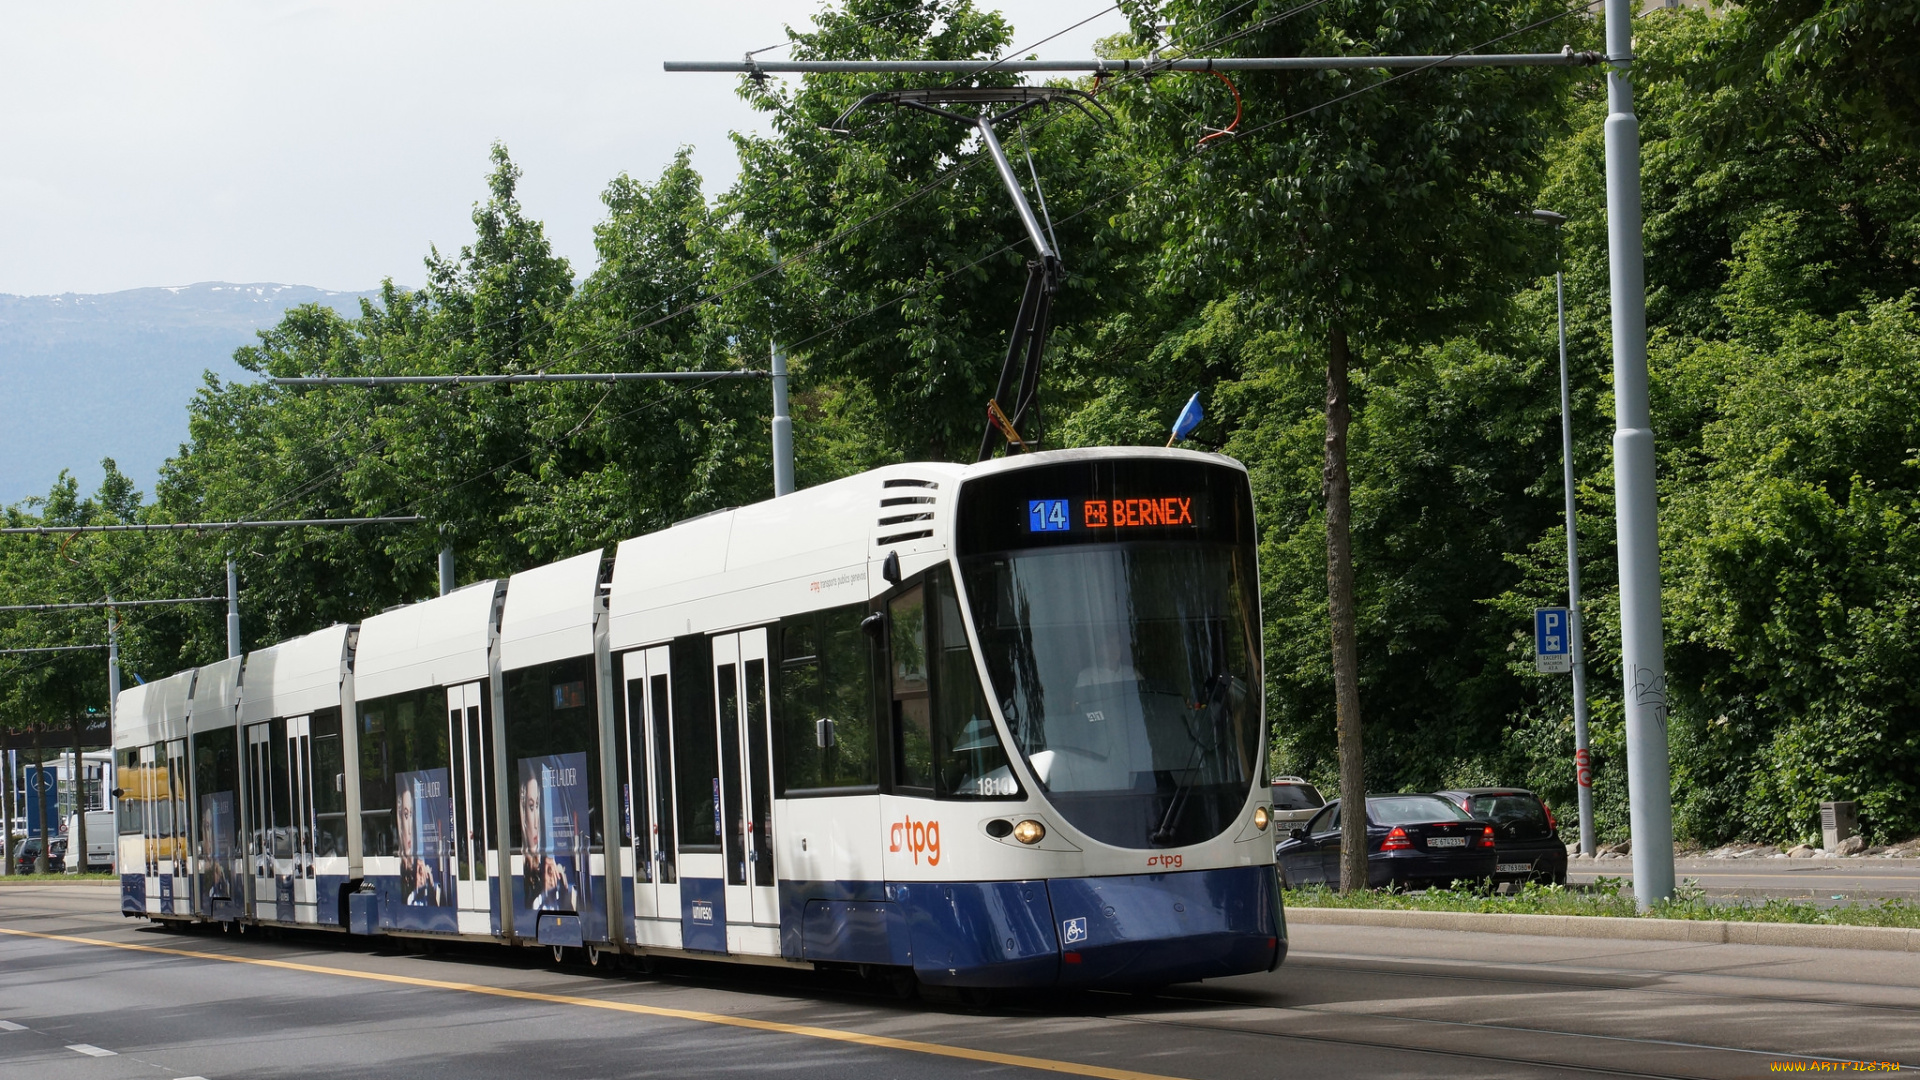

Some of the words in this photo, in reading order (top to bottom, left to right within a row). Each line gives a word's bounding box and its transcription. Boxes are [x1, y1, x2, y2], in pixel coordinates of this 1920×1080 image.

[1033, 501, 1066, 529] 14
[1085, 504, 1107, 524] P+R
[1113, 498, 1192, 526] BERNEX
[1545, 613, 1559, 635] P
[556, 768, 577, 787] LAUDER
[978, 777, 1010, 796] 1810
[905, 814, 940, 866] tpg
[1160, 854, 1182, 868] tpg
